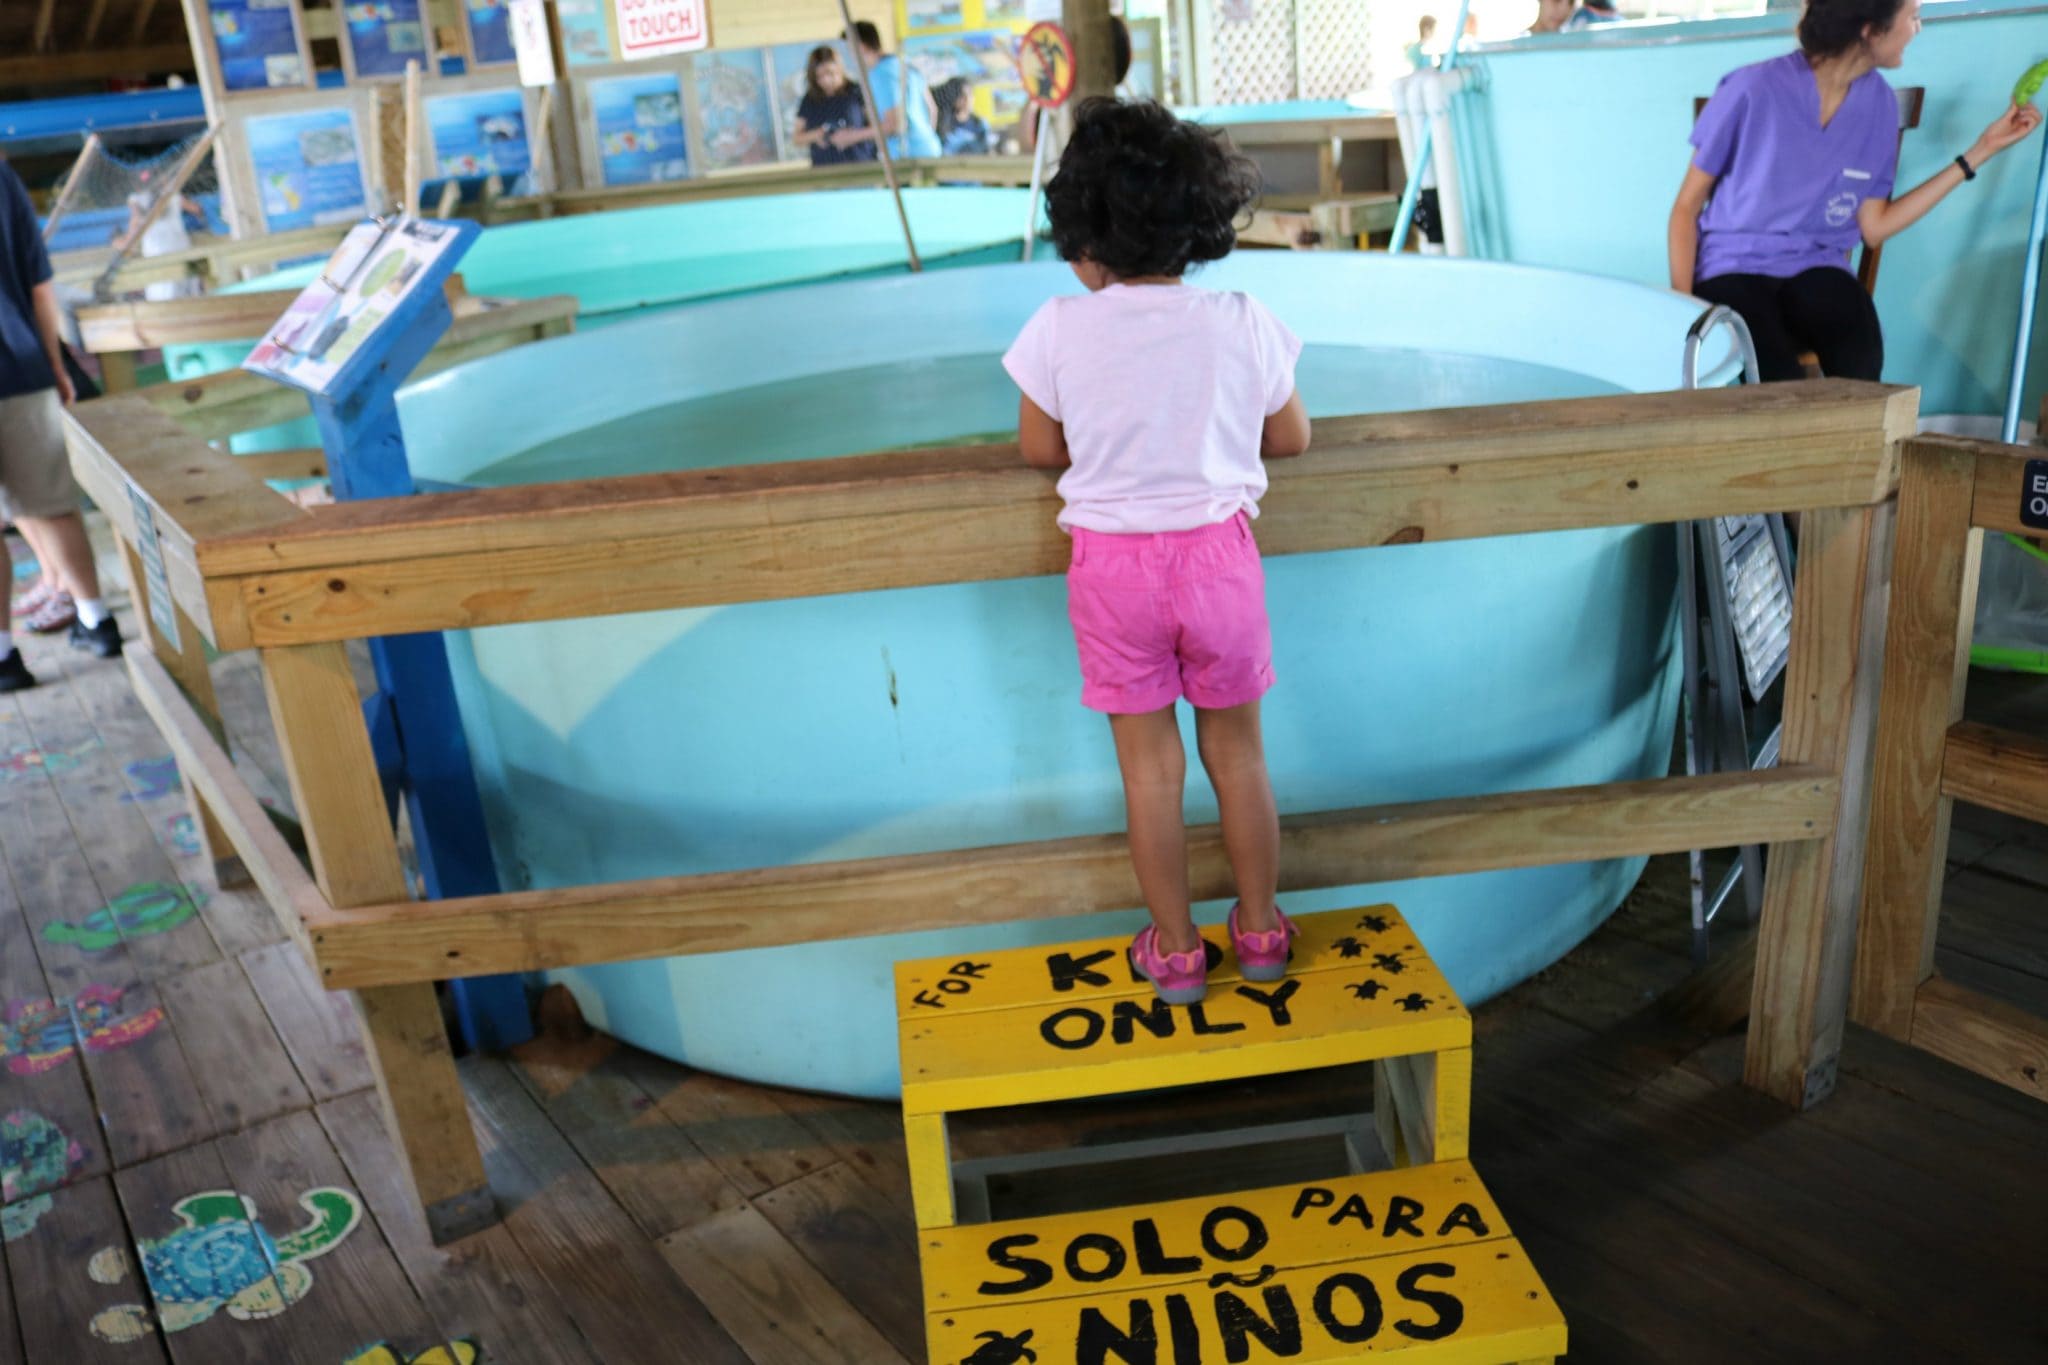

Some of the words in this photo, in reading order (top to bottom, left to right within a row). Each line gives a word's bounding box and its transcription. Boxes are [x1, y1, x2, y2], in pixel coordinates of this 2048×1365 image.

[628, 9, 691, 40] TOUCH
[2030, 497, 2048, 516] O
[2033, 474, 2048, 494] E
[912, 961, 991, 1008] FOR
[1039, 979, 1301, 1049] ONLY
[977, 1206, 1269, 1296] SOLO
[1291, 1188, 1490, 1237] PARA
[1076, 1262, 1464, 1365] NIÑOS
